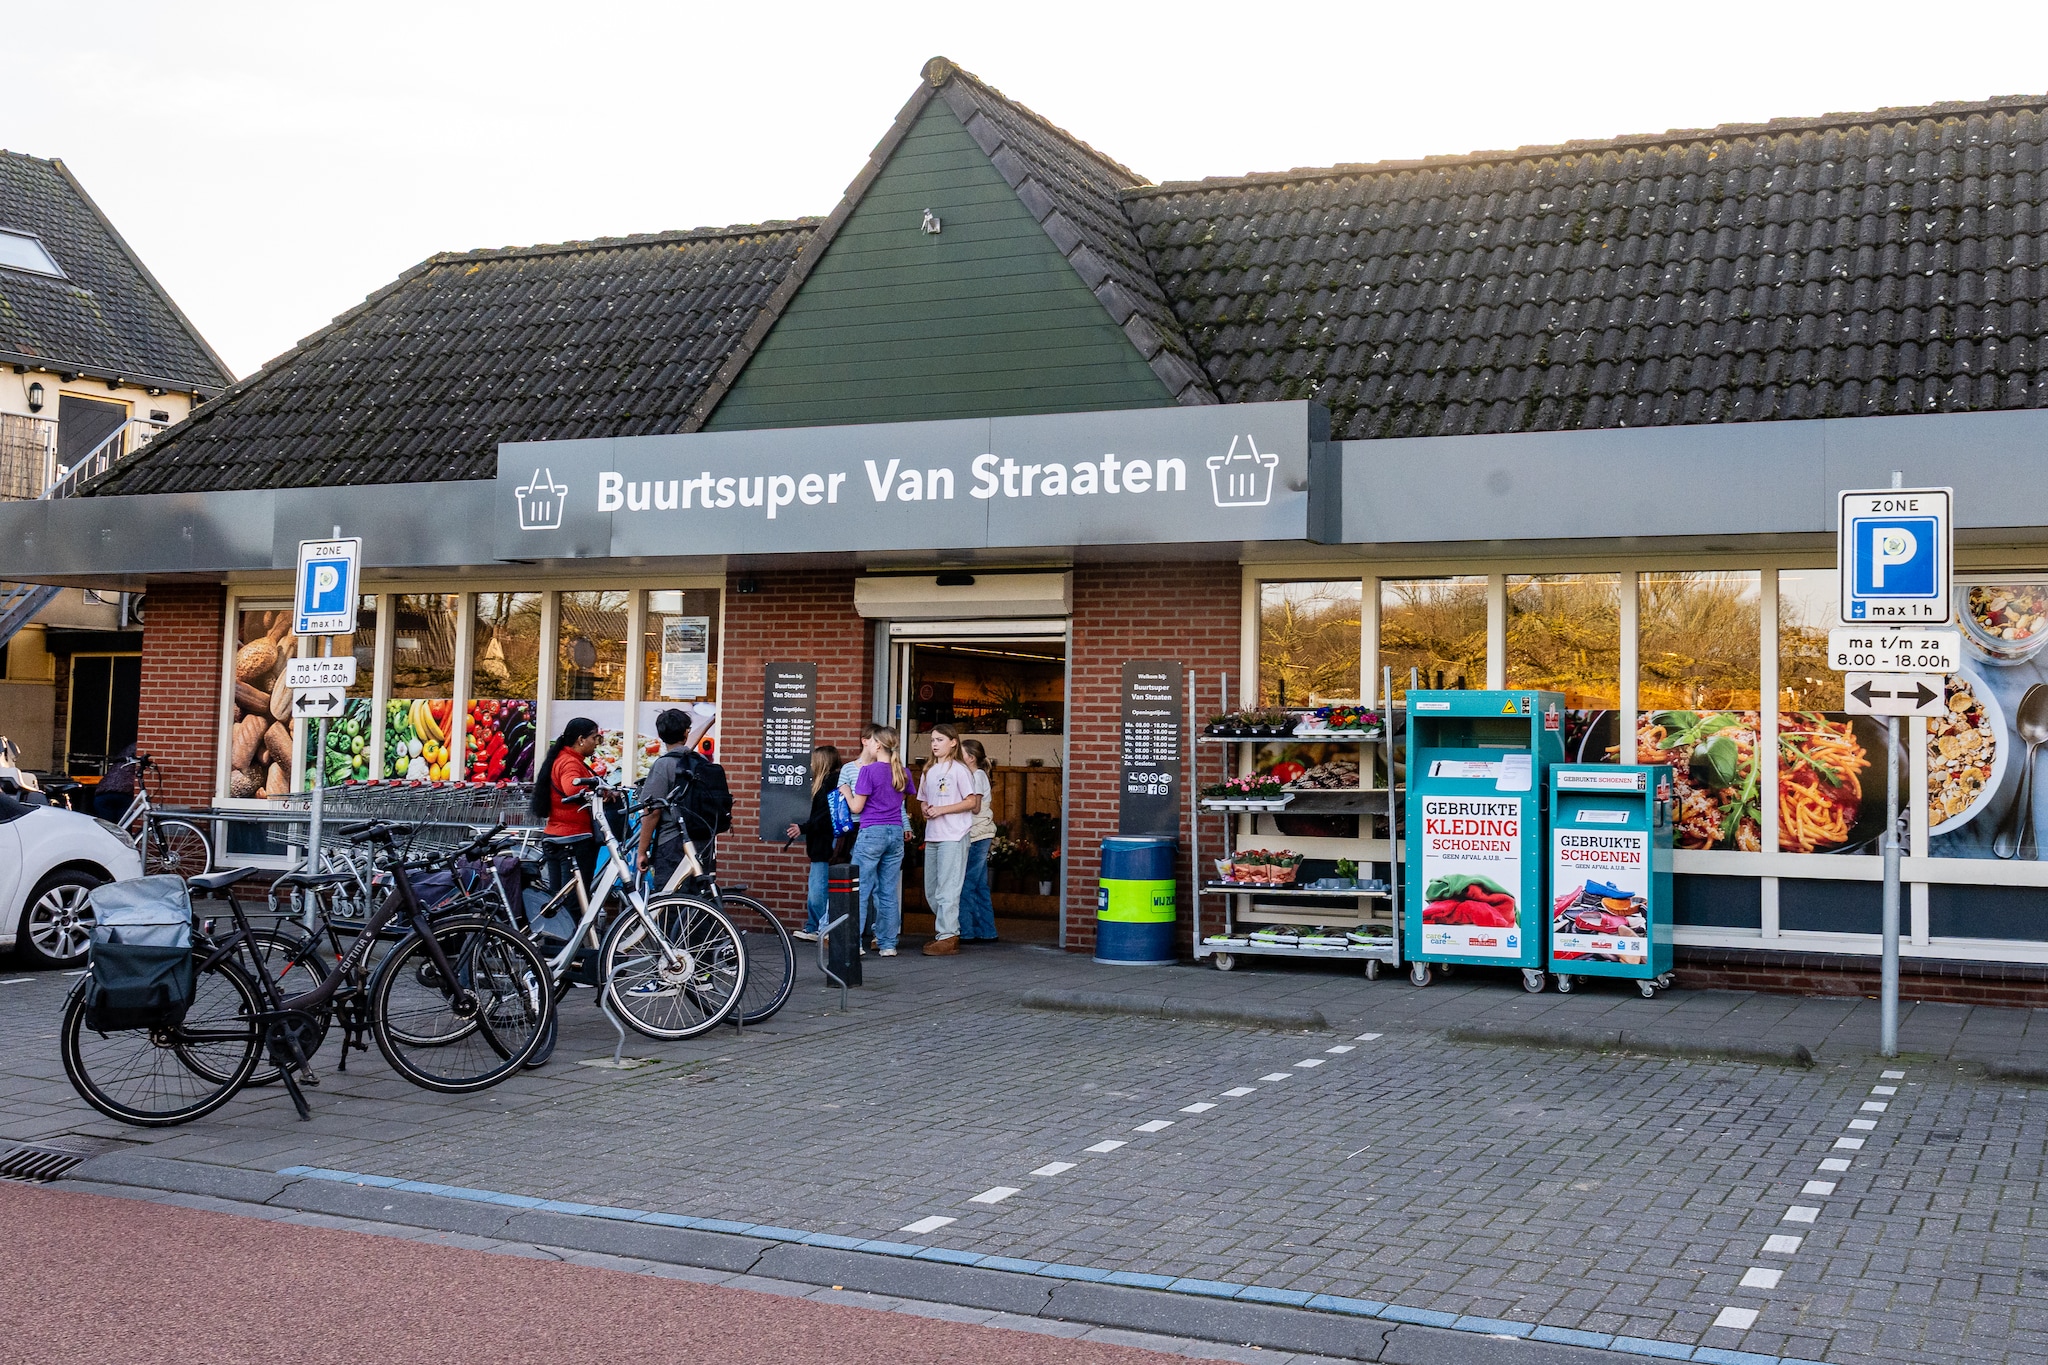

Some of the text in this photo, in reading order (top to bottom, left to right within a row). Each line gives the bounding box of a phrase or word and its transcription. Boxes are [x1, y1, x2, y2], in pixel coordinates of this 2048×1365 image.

[598, 453, 1187, 518] Buurtsuper Van Straaten
[1871, 499, 1919, 512] ZONE
[316, 546, 341, 555] ZONE
[1872, 527, 1918, 588] P
[312, 566, 339, 609] P
[1873, 604, 1932, 616] max 1 h
[338, 618, 343, 627] h
[1849, 636, 1940, 650] ma t/m za
[297, 664, 310, 672] ma
[313, 662, 330, 671] t/m
[1837, 654, 1876, 666] 8.00
[1895, 655, 1950, 668] 18.00h
[290, 675, 310, 684] 8.00
[320, 673, 348, 684] 18.00h
[774, 683, 805, 691] Buurtsuper
[1133, 684, 1170, 692] Buurtsuper
[1145, 693, 1172, 701] Straaten
[1426, 802, 1518, 816] GEBRUIKTE
[1426, 818, 1518, 837] KLEDING
[1432, 839, 1511, 852] SCHOENEN
[1560, 835, 1641, 849] GEBRUIKTE
[1561, 849, 1641, 863] SCHOENEN
[340, 938, 368, 974] CORTINA
